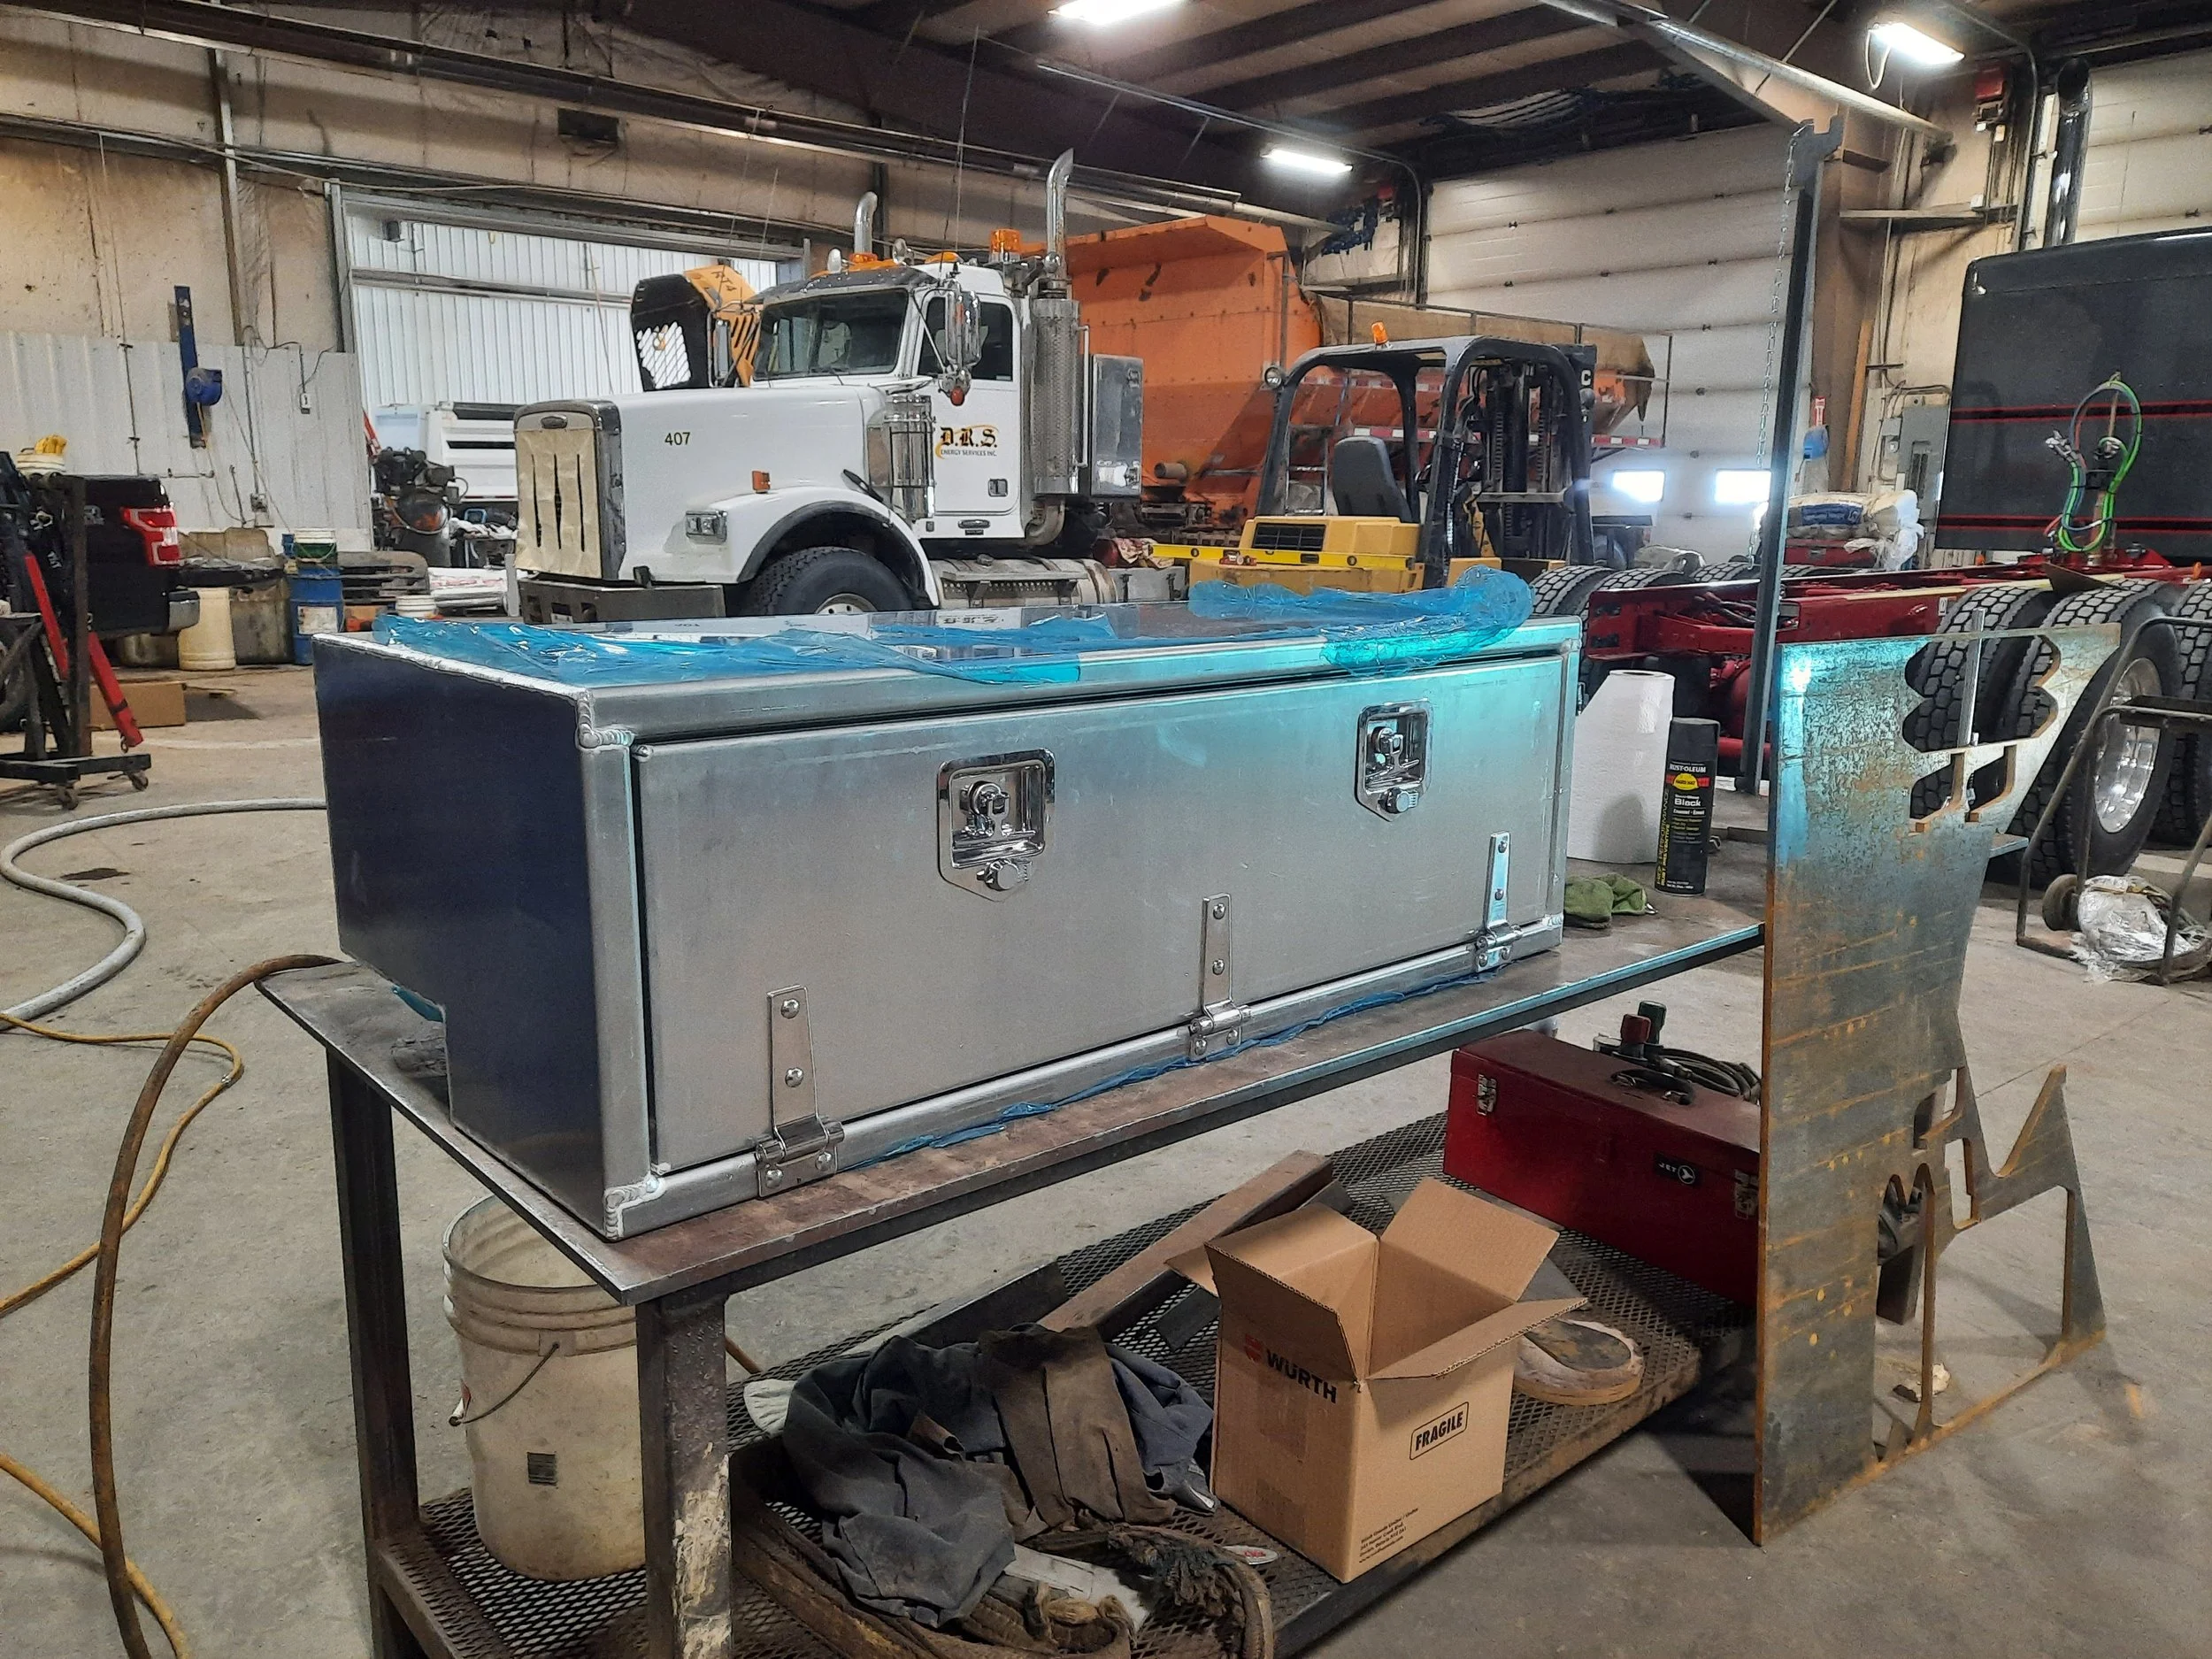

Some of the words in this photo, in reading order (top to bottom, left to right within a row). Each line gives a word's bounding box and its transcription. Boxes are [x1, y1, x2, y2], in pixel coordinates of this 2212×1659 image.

[664, 432, 690, 446] 407
[940, 426, 998, 448] D.R.S.
[1674, 797, 1701, 806] Black
[1657, 1162, 1677, 1173] JET
[1415, 1410, 1463, 1451] FRAGILE
